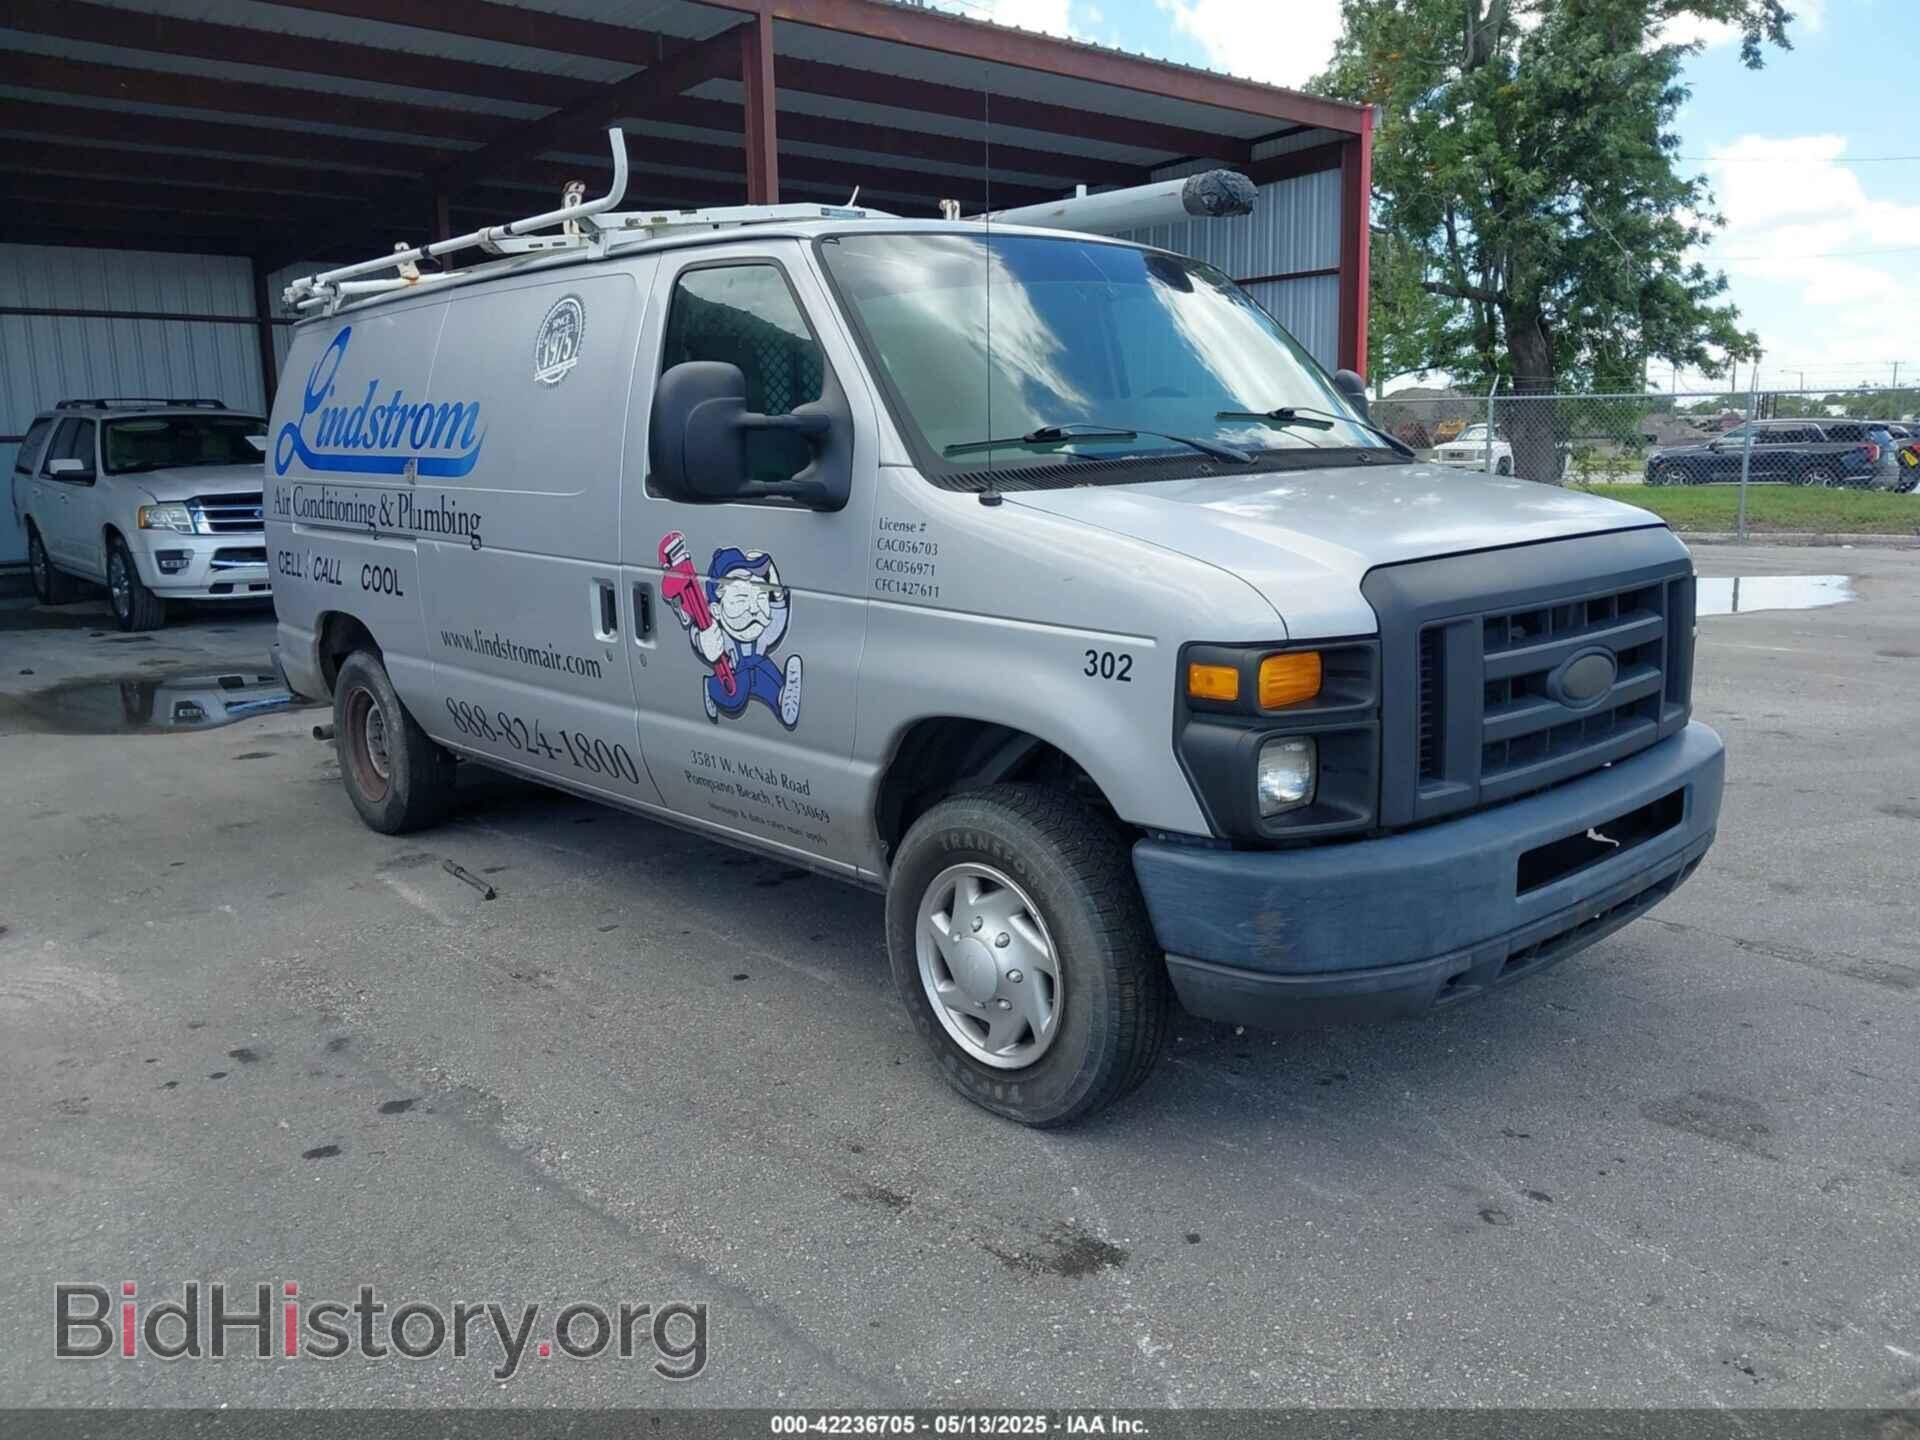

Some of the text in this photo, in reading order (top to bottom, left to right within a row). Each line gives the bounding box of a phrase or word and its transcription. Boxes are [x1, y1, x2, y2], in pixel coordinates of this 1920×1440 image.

[275, 326, 487, 478] Lindstrom
[273, 485, 483, 550] Air Conditioning & Plumbing
[879, 517, 916, 533] License
[876, 538, 938, 556] CAC056703
[278, 550, 404, 597] CELL CALL COOL
[875, 558, 935, 577] CAC056971
[874, 578, 940, 599] CFC1427611
[440, 629, 602, 679] www.lindstromair.com
[1084, 648, 1133, 682] 302
[445, 696, 640, 785] 888-824-1800
[683, 770, 735, 795] Pompano
[690, 750, 717, 769] 3581
[738, 761, 778, 786] McNab
[780, 773, 811, 796] Road
